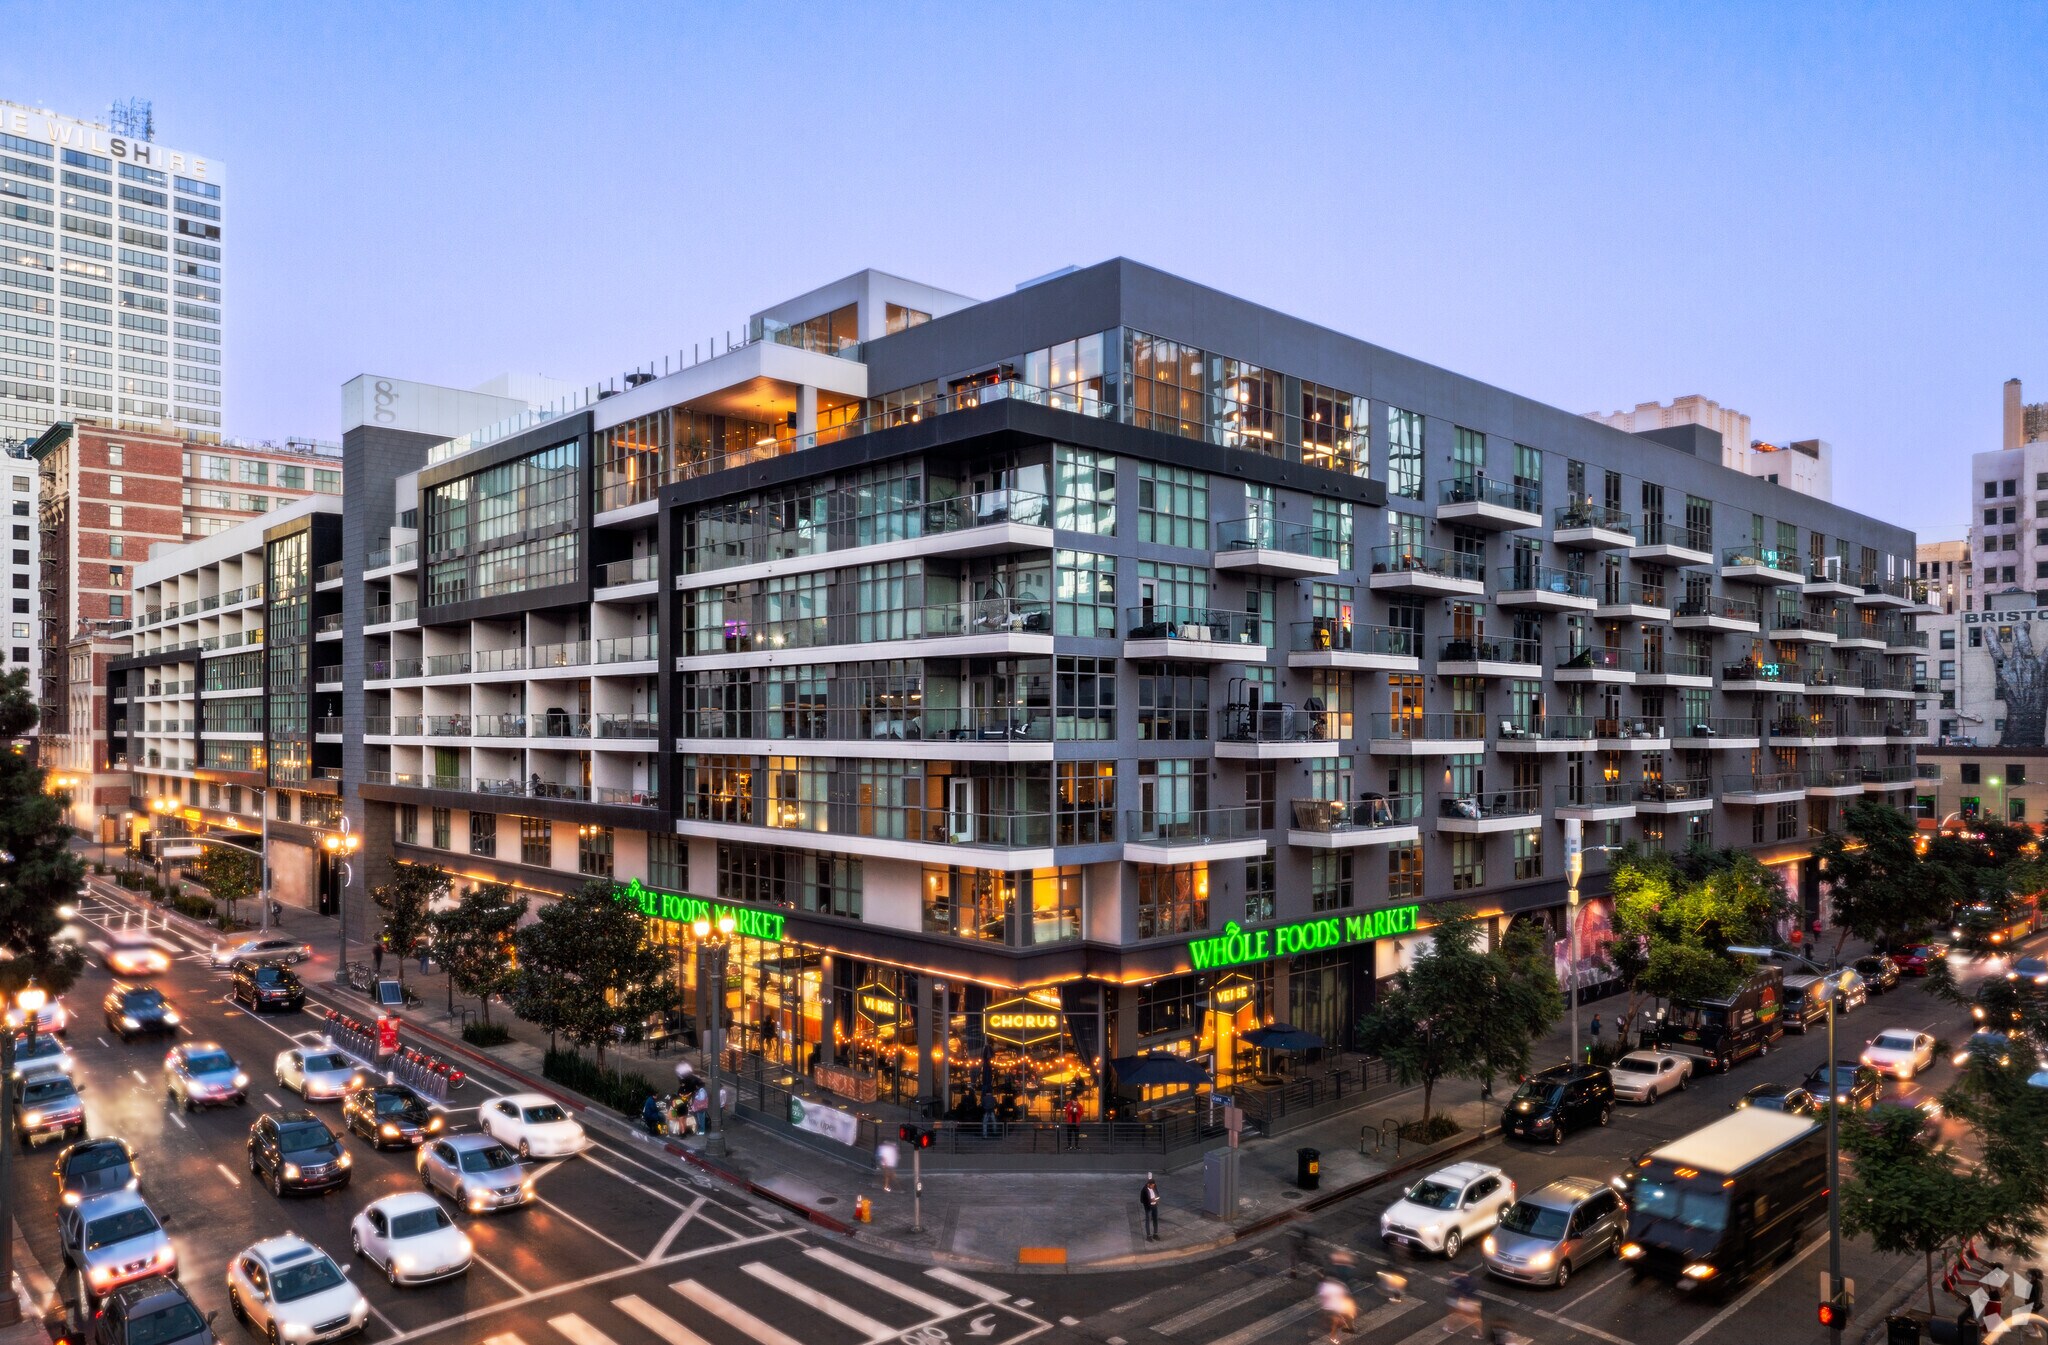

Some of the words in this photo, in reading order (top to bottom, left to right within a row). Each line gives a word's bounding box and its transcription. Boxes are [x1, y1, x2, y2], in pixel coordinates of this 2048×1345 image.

[47, 120, 207, 179] WILSHIRE
[662, 894, 709, 924] FOODS
[714, 904, 785, 941] MARKET
[1189, 926, 1269, 970] WHOLE
[1275, 918, 1340, 955] FOODS
[1346, 905, 1420, 943] MARKET
[989, 1015, 1057, 1028] CHORUS
